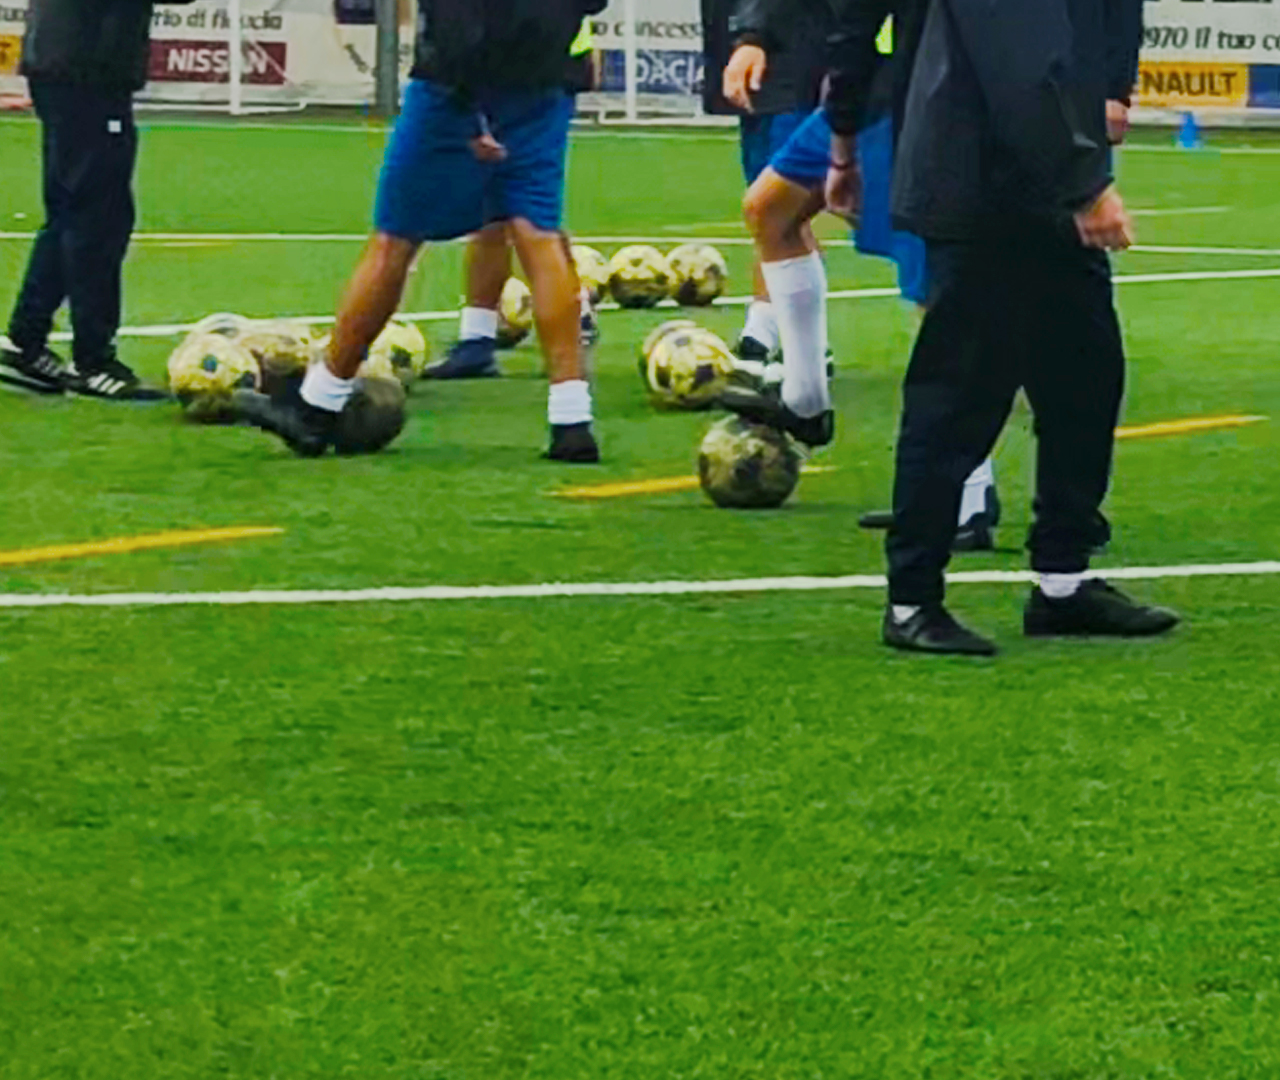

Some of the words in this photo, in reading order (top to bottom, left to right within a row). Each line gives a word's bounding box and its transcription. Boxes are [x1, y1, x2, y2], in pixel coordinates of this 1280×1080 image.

[212, 8, 283, 30] fiucia
[1218, 30, 1255, 49] tuo
[167, 48, 268, 74] NISSN
[1140, 71, 1237, 97] NAULT
